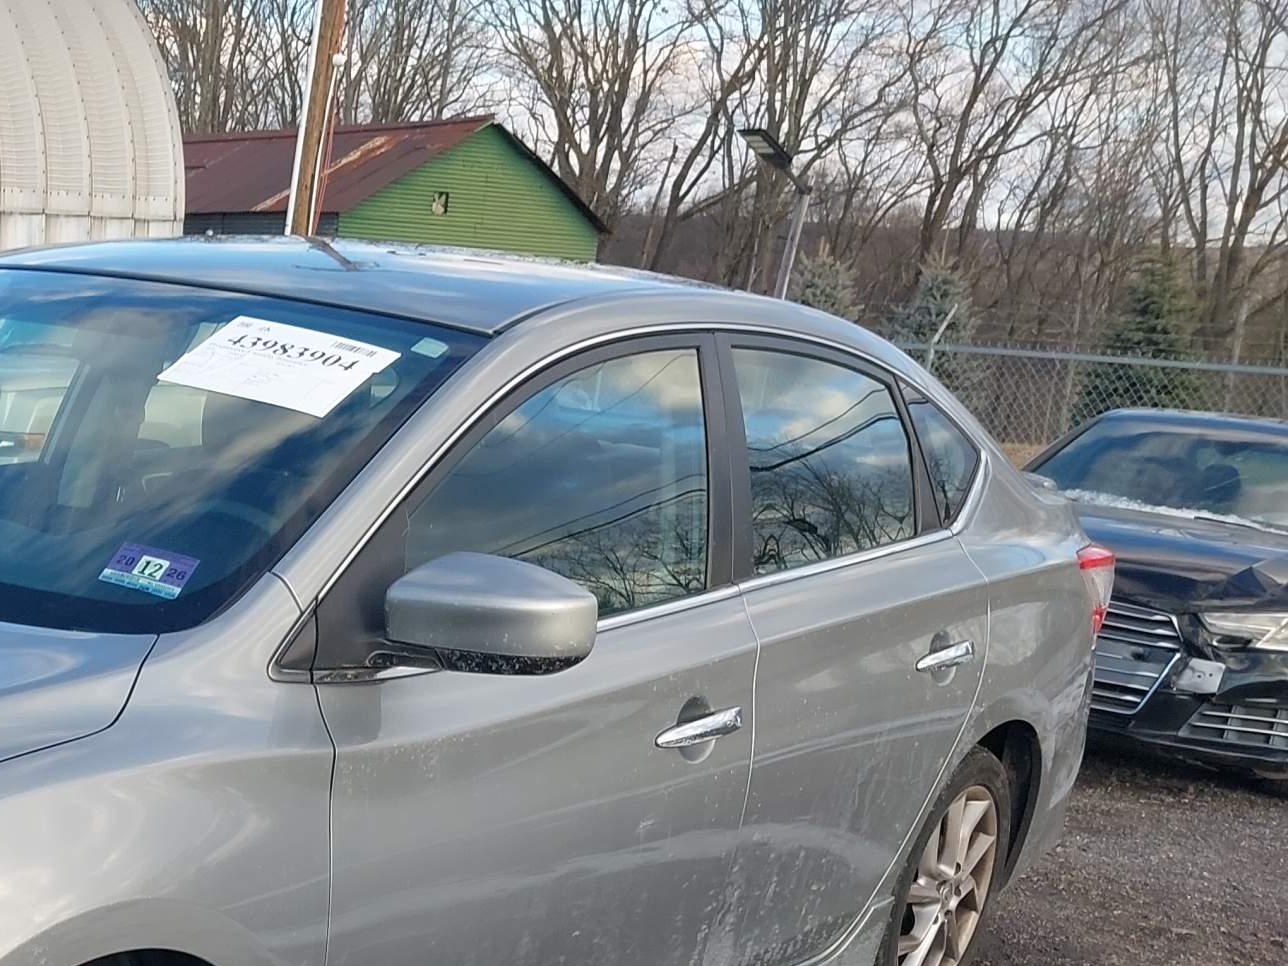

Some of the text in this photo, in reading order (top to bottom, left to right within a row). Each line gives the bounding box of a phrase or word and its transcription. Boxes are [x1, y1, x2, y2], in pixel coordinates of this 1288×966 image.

[227, 333, 361, 372] 43983904
[116, 554, 187, 581] 20 12 26
